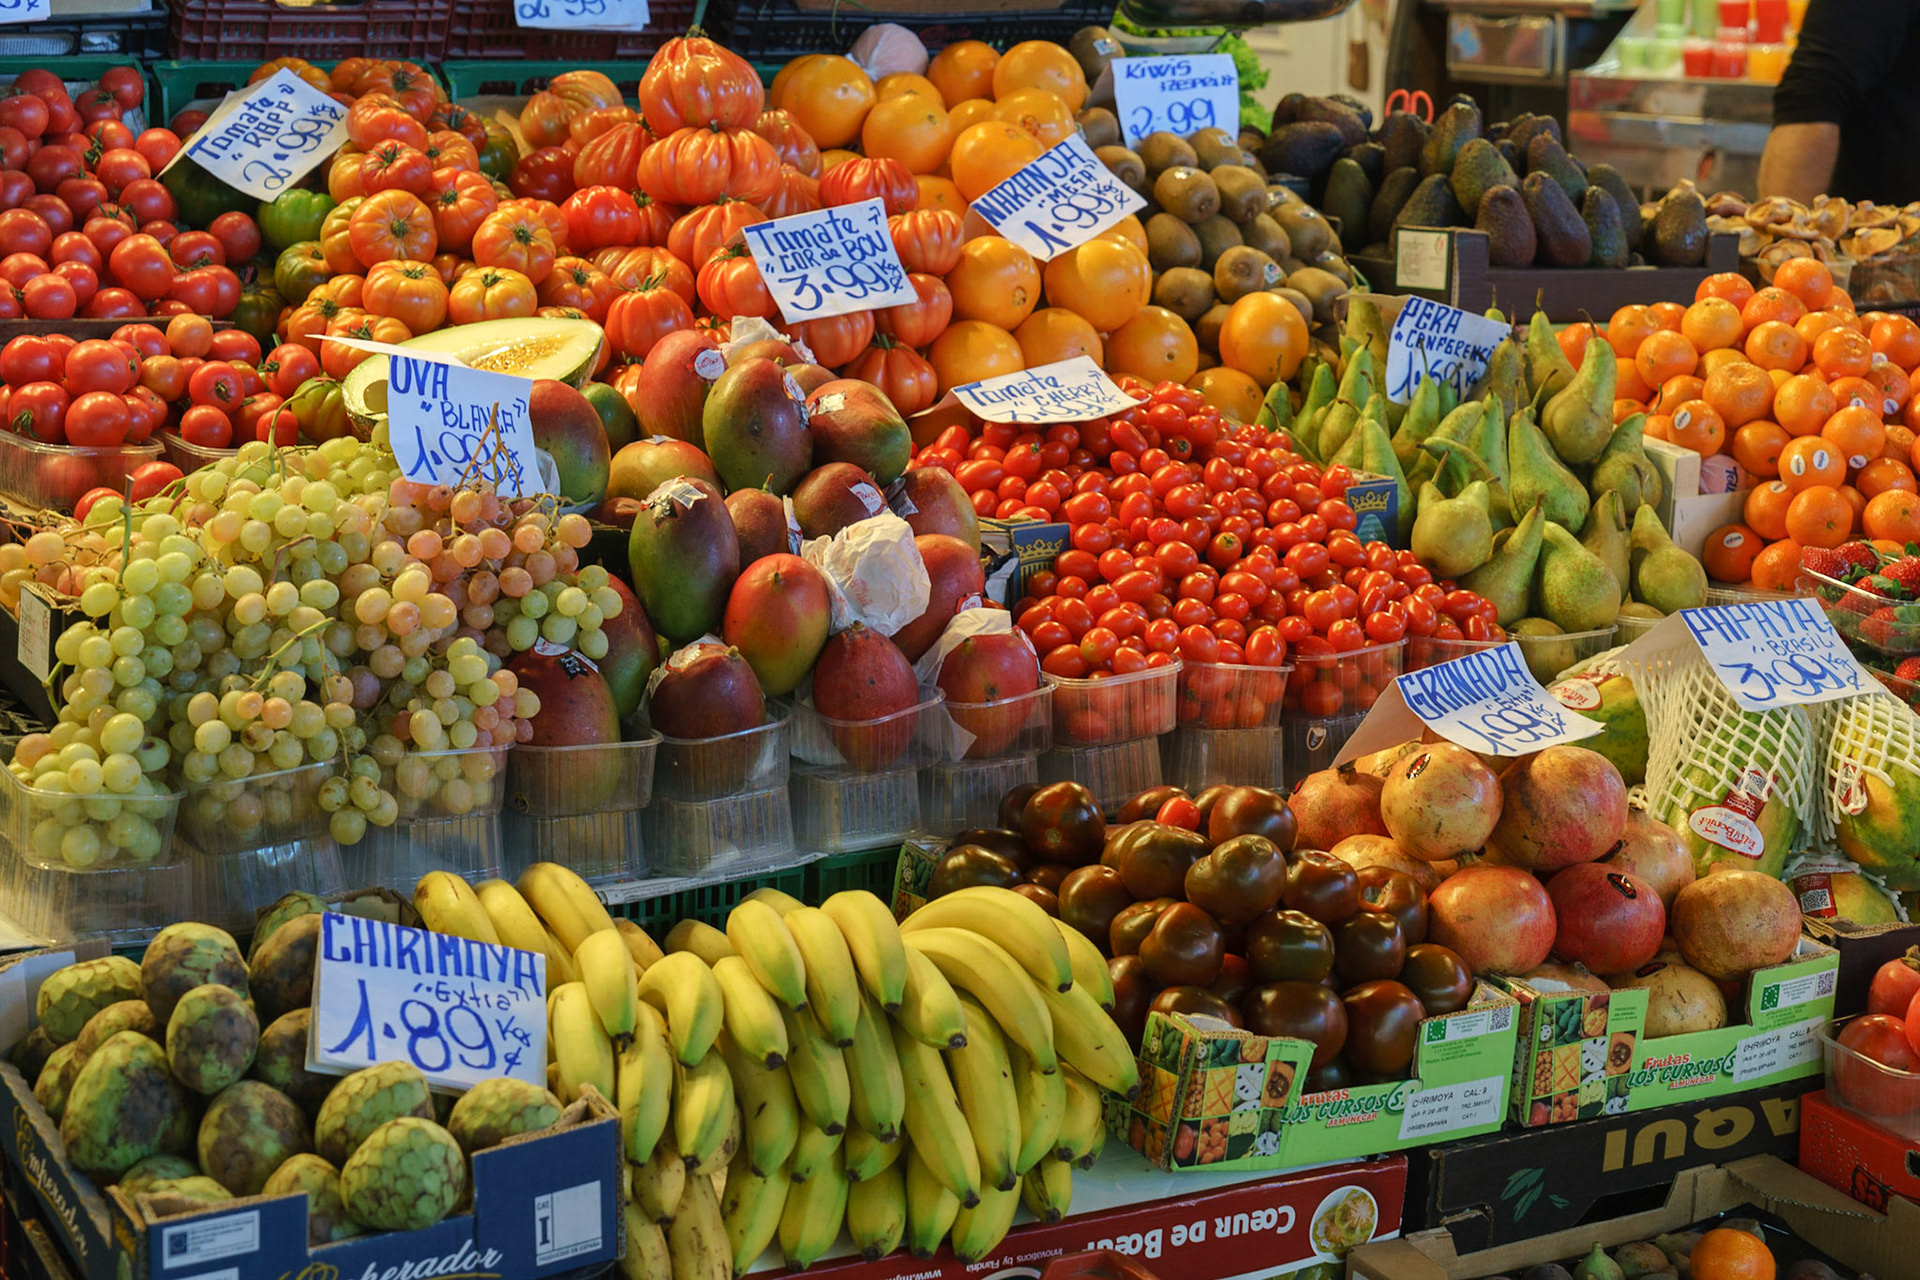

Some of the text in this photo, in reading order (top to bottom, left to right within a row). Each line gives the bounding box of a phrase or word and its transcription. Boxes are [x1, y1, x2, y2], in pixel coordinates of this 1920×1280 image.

[187, 97, 275, 160] Tomate
[243, 118, 335, 190] 2.99
[970, 141, 1087, 226] NARANJA
[745, 210, 859, 256] Tomate
[1024, 192, 1115, 257] 1.99
[778, 261, 890, 311] 3.99
[1396, 297, 1463, 334] PERA
[391, 355, 449, 400] UVA
[954, 369, 1064, 407] Tomate
[1680, 600, 1823, 646] PAPAYA
[1397, 644, 1525, 721] GRANADA
[1719, 653, 1846, 702] 3.99
[1457, 708, 1561, 755] 1.99
[322, 911, 543, 997] CHIRIMOYA
[323, 978, 497, 1073] 1.89
[1627, 1068, 1659, 1088] LOS
[1661, 1057, 1724, 1083] CURSOS
[1645, 1053, 1690, 1069] Frutas
[1280, 1105, 1315, 1124] LOS
[1318, 1093, 1388, 1119] CURSOS
[1300, 1088, 1350, 1107] Frutas
[966, 1247, 1063, 1273] Innovations by Flandria
